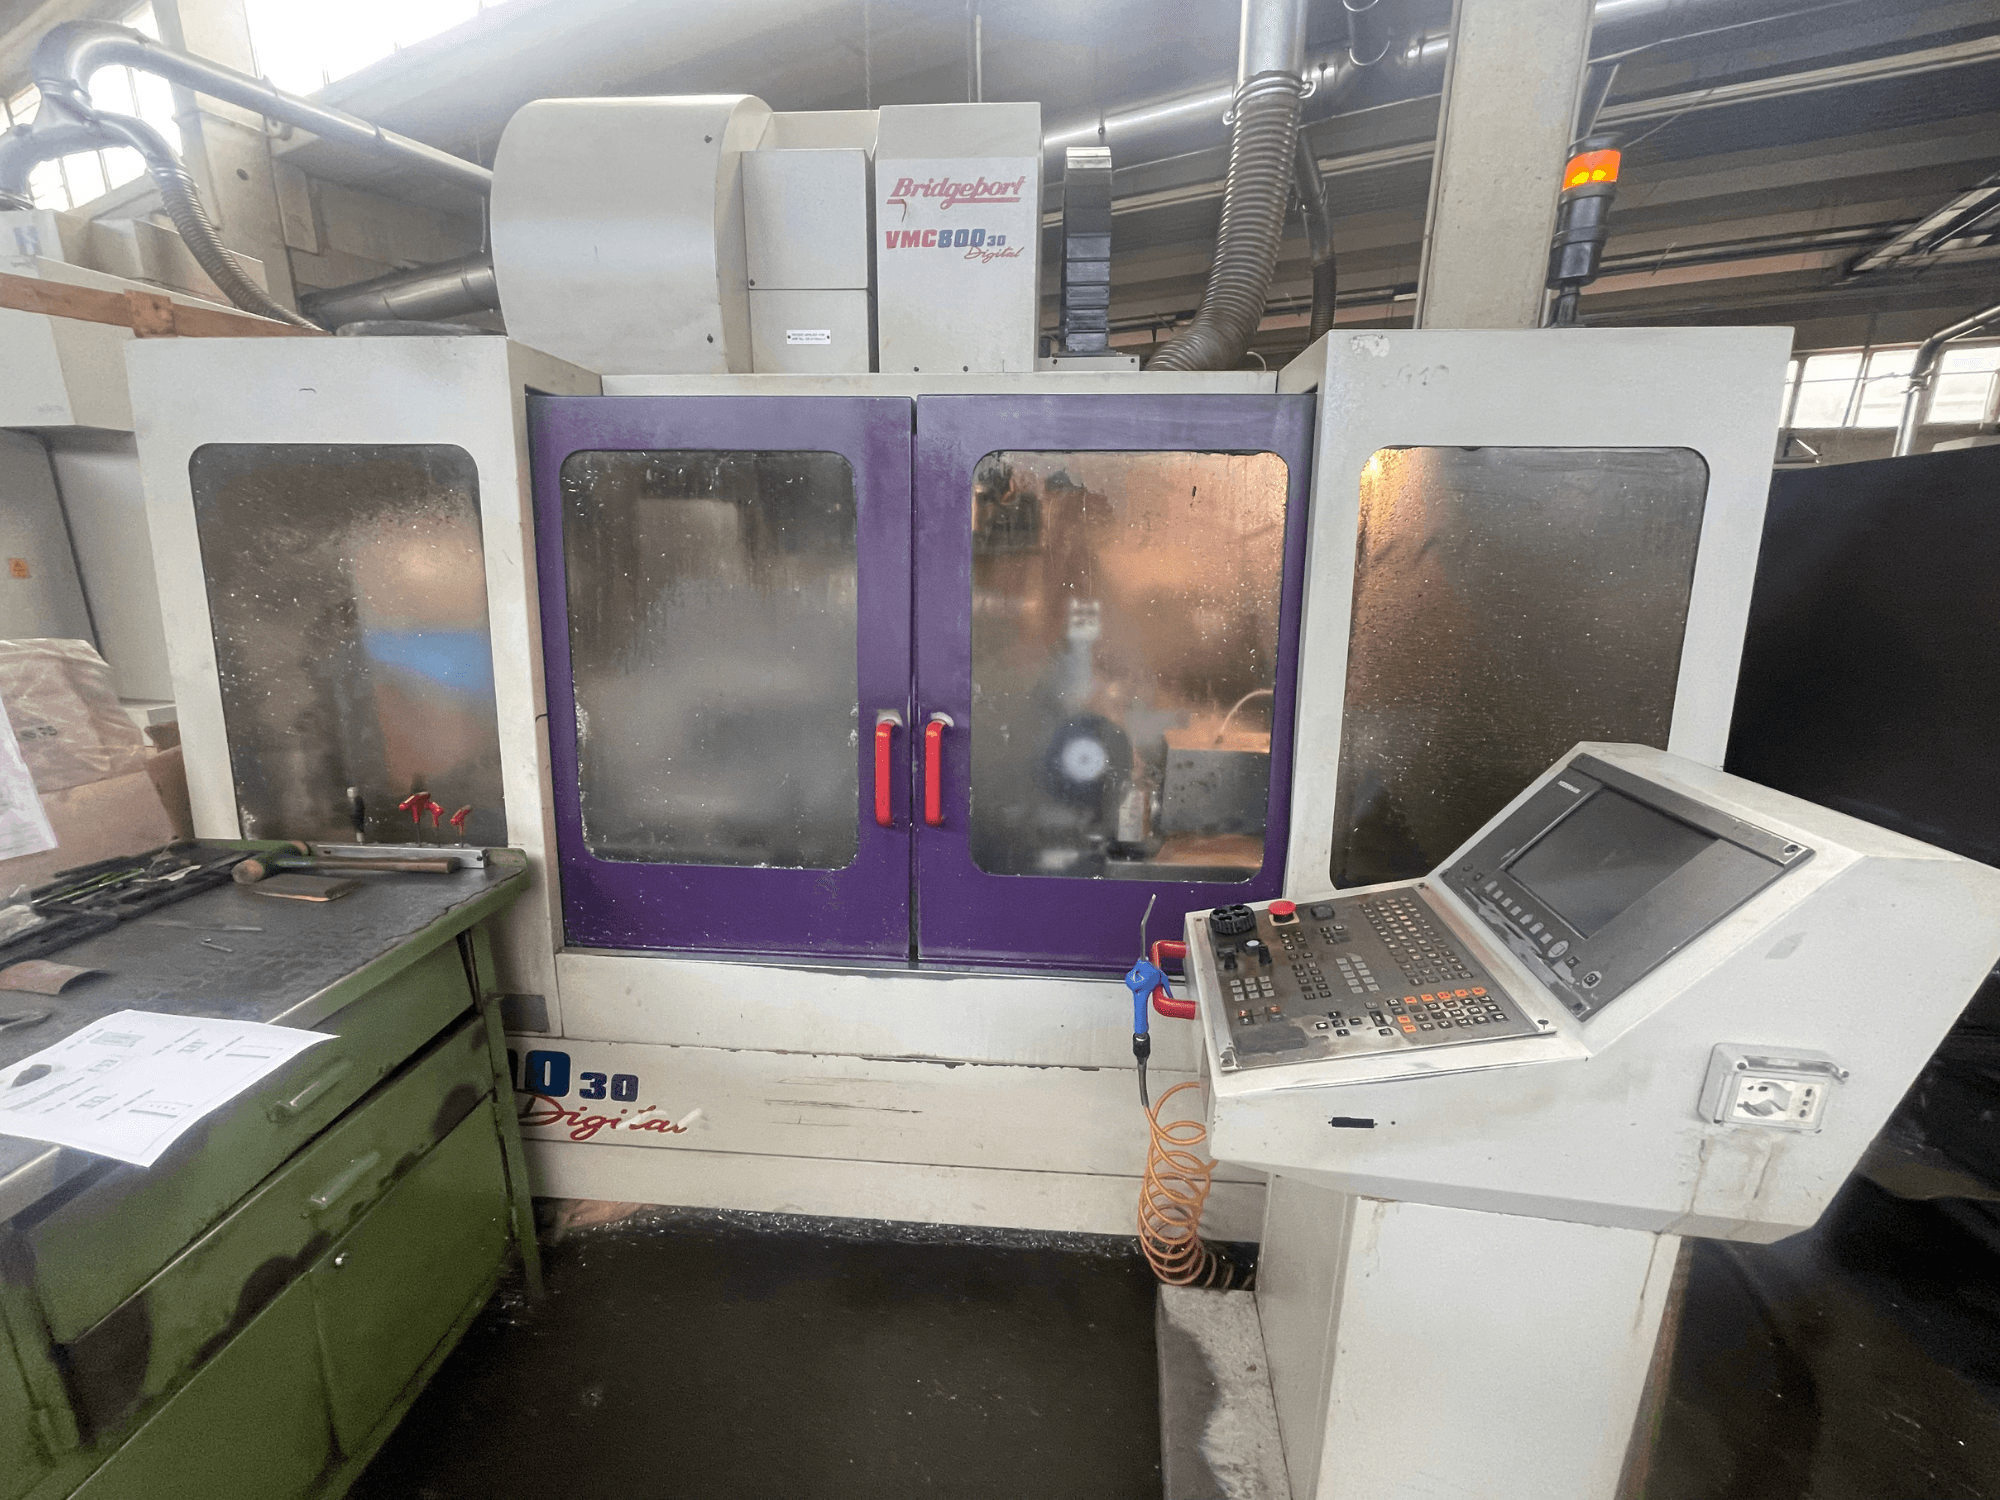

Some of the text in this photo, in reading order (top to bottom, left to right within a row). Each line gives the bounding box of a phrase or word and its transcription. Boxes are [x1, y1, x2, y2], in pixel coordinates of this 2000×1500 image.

[888, 175, 1026, 210] Bridgeport
[964, 244, 1025, 264] Digital
[579, 1072, 639, 1102] 30
